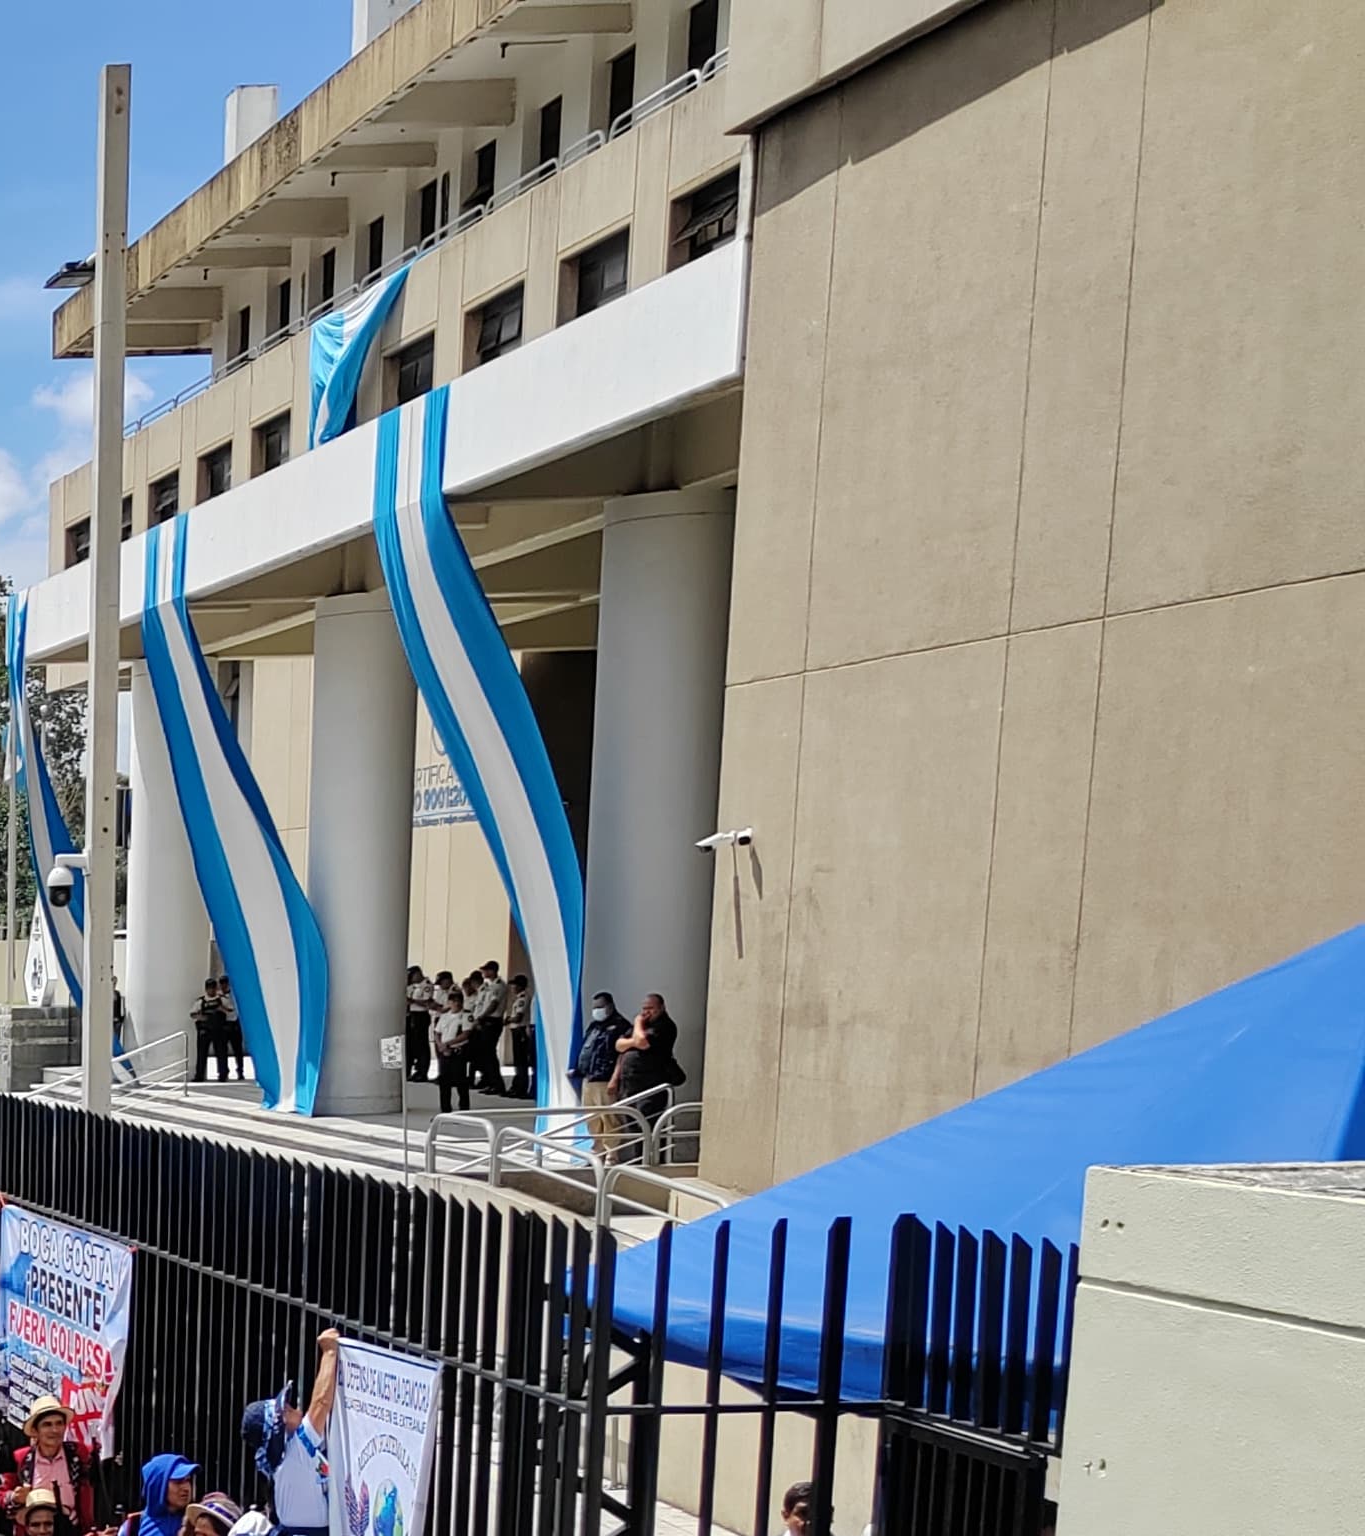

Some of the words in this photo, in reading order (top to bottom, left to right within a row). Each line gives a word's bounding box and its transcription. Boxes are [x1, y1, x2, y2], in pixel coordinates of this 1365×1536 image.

[20, 1217, 59, 1268] BOCA
[63, 1233, 114, 1291] COSTA
[9, 1301, 47, 1349] FUERA
[26, 1266, 107, 1333] ¡PRESENTE!
